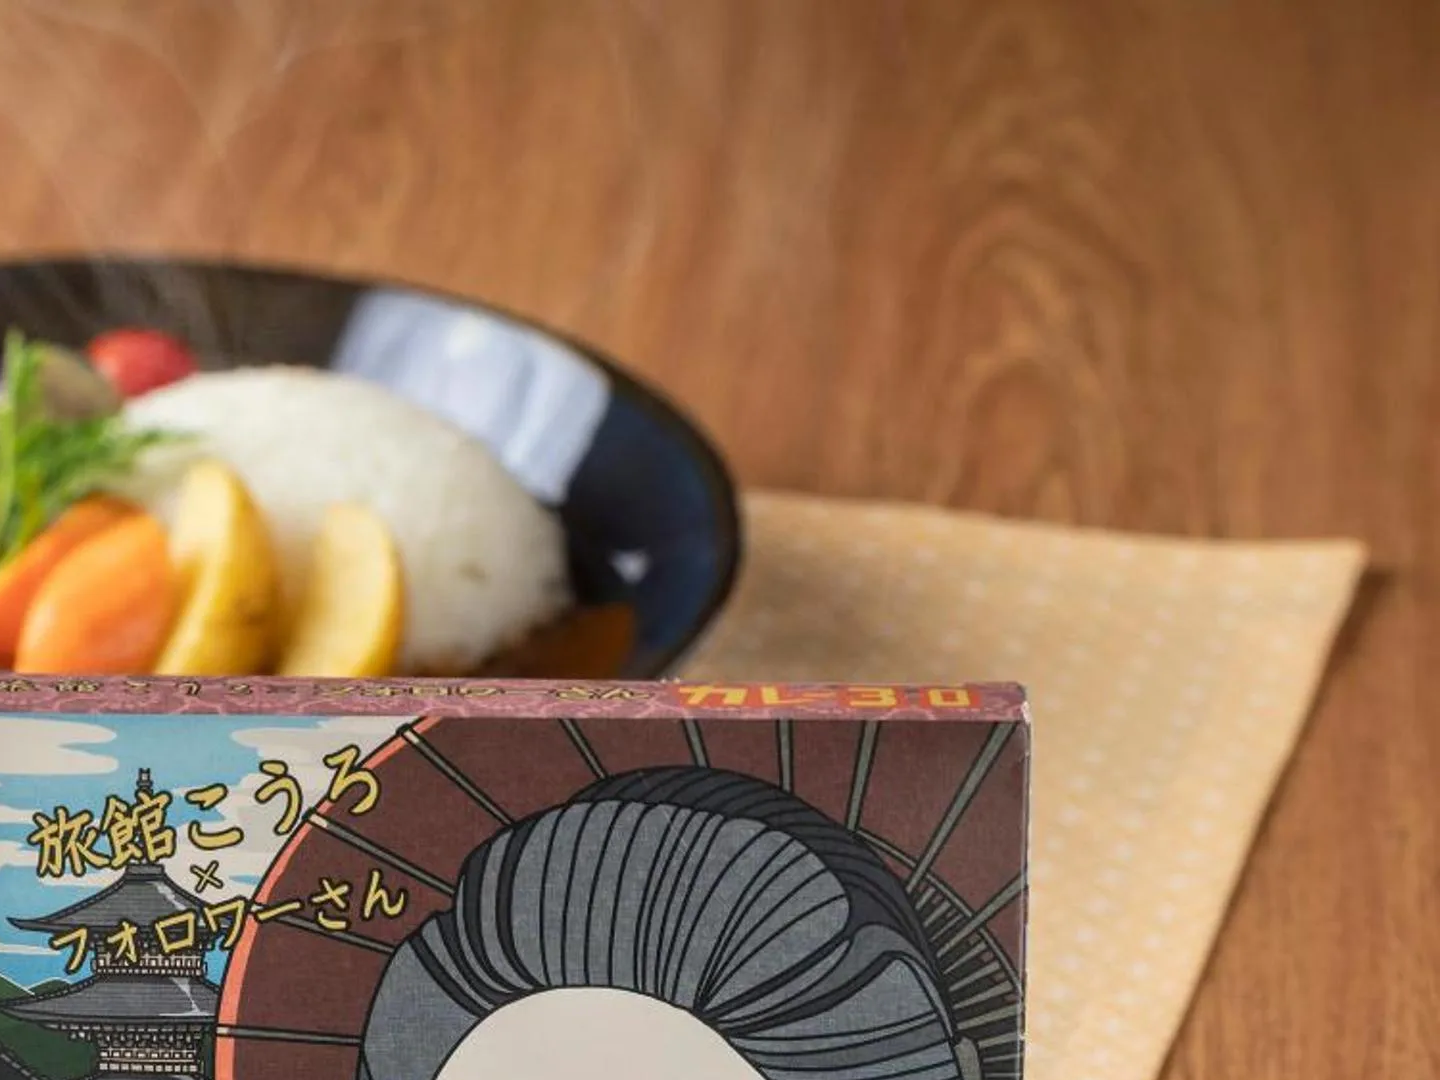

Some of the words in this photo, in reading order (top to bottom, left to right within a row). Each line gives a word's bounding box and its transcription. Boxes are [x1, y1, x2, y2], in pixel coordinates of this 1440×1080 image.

[27, 744, 382, 878] 旅館こうろ
[48, 868, 406, 974] フォロワーさん
